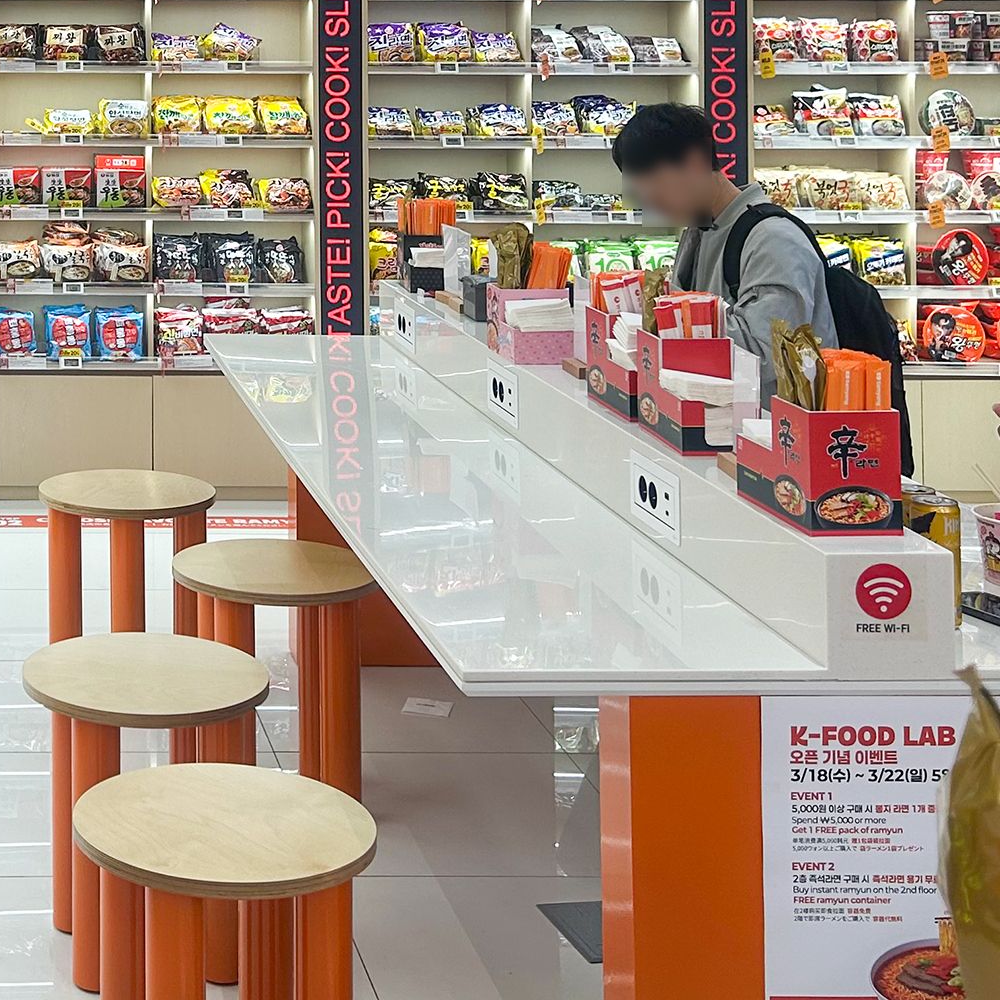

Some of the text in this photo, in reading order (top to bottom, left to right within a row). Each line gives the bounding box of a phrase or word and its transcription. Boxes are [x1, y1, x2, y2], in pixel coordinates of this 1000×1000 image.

[325, 47, 350, 142] COOK!
[711, 48, 736, 143] COOK!
[325, 152, 351, 228] PICK!
[325, 239, 351, 336] TASTE!
[827, 425, 869, 480] 辛
[856, 624, 881, 633] FREE
[790, 726, 956, 746] K-FOOD LAB
[790, 750, 898, 764] 오픈 기념 이벤트
[791, 768, 851, 783] 3/18(수)
[868, 768, 927, 783] 3/22(일)
[791, 792, 825, 801] EVENT
[791, 805, 826, 814] 5,000원
[828, 805, 845, 813] 이상
[847, 805, 863, 813] 구매
[865, 805, 873, 813] 시
[893, 805, 909, 813] 라면
[913, 805, 926, 813] 1개
[792, 817, 818, 825] Spend
[792, 826, 807, 834] Get
[839, 826, 859, 836] pack
[870, 828, 903, 836] ramyun
[792, 862, 835, 871] EVENT 2
[793, 875, 807, 884] 2층
[809, 875, 841, 884] 즉석라면
[862, 875, 870, 883] 시
[872, 875, 905, 884] 즉석라면
[793, 886, 809, 895] Buy
